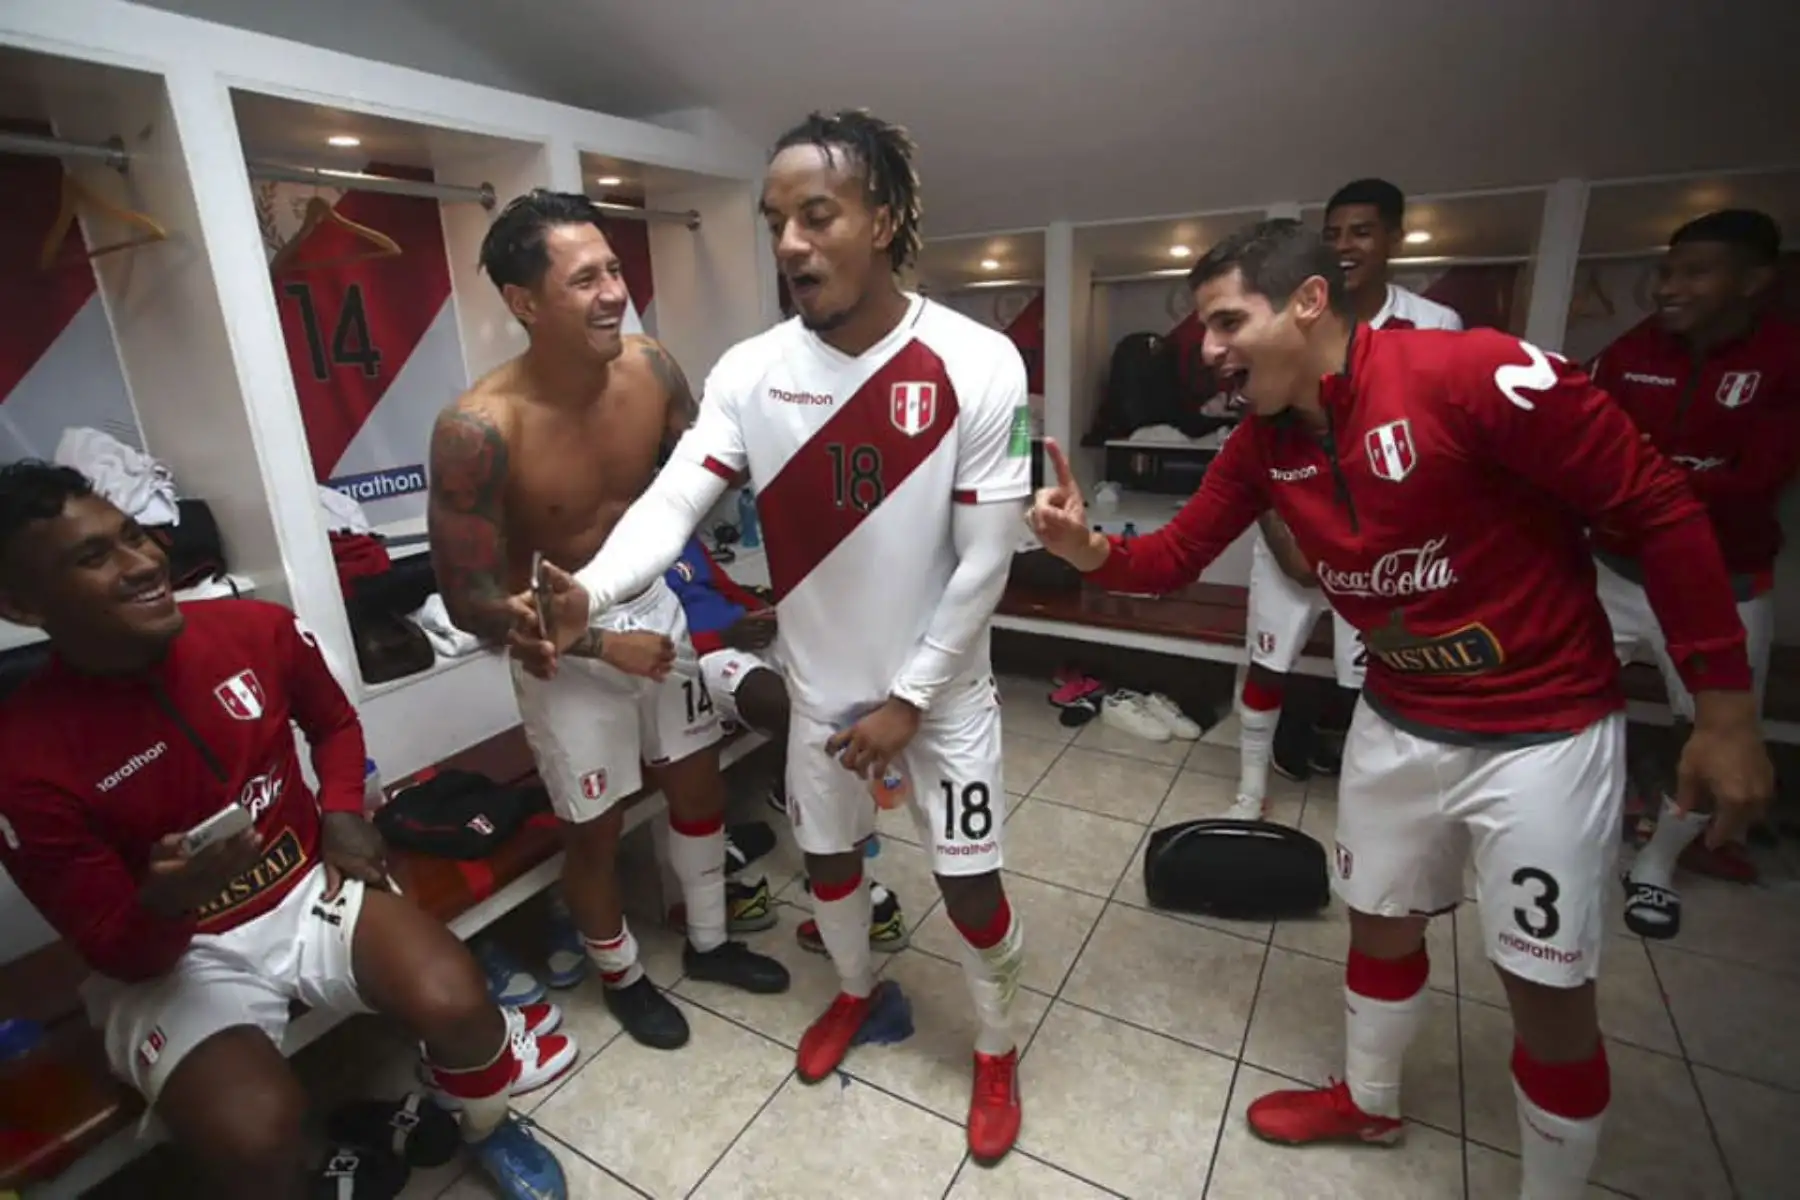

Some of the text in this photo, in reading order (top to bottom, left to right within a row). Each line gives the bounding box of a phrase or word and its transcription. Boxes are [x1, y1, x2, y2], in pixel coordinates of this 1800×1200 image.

[283, 281, 382, 380] 14
[336, 472, 423, 500] arathon
[824, 442, 886, 513] 18
[681, 668, 714, 724] 14
[940, 779, 993, 840] 18
[1510, 866, 1560, 940] 3
[1638, 886, 1668, 908] 20
